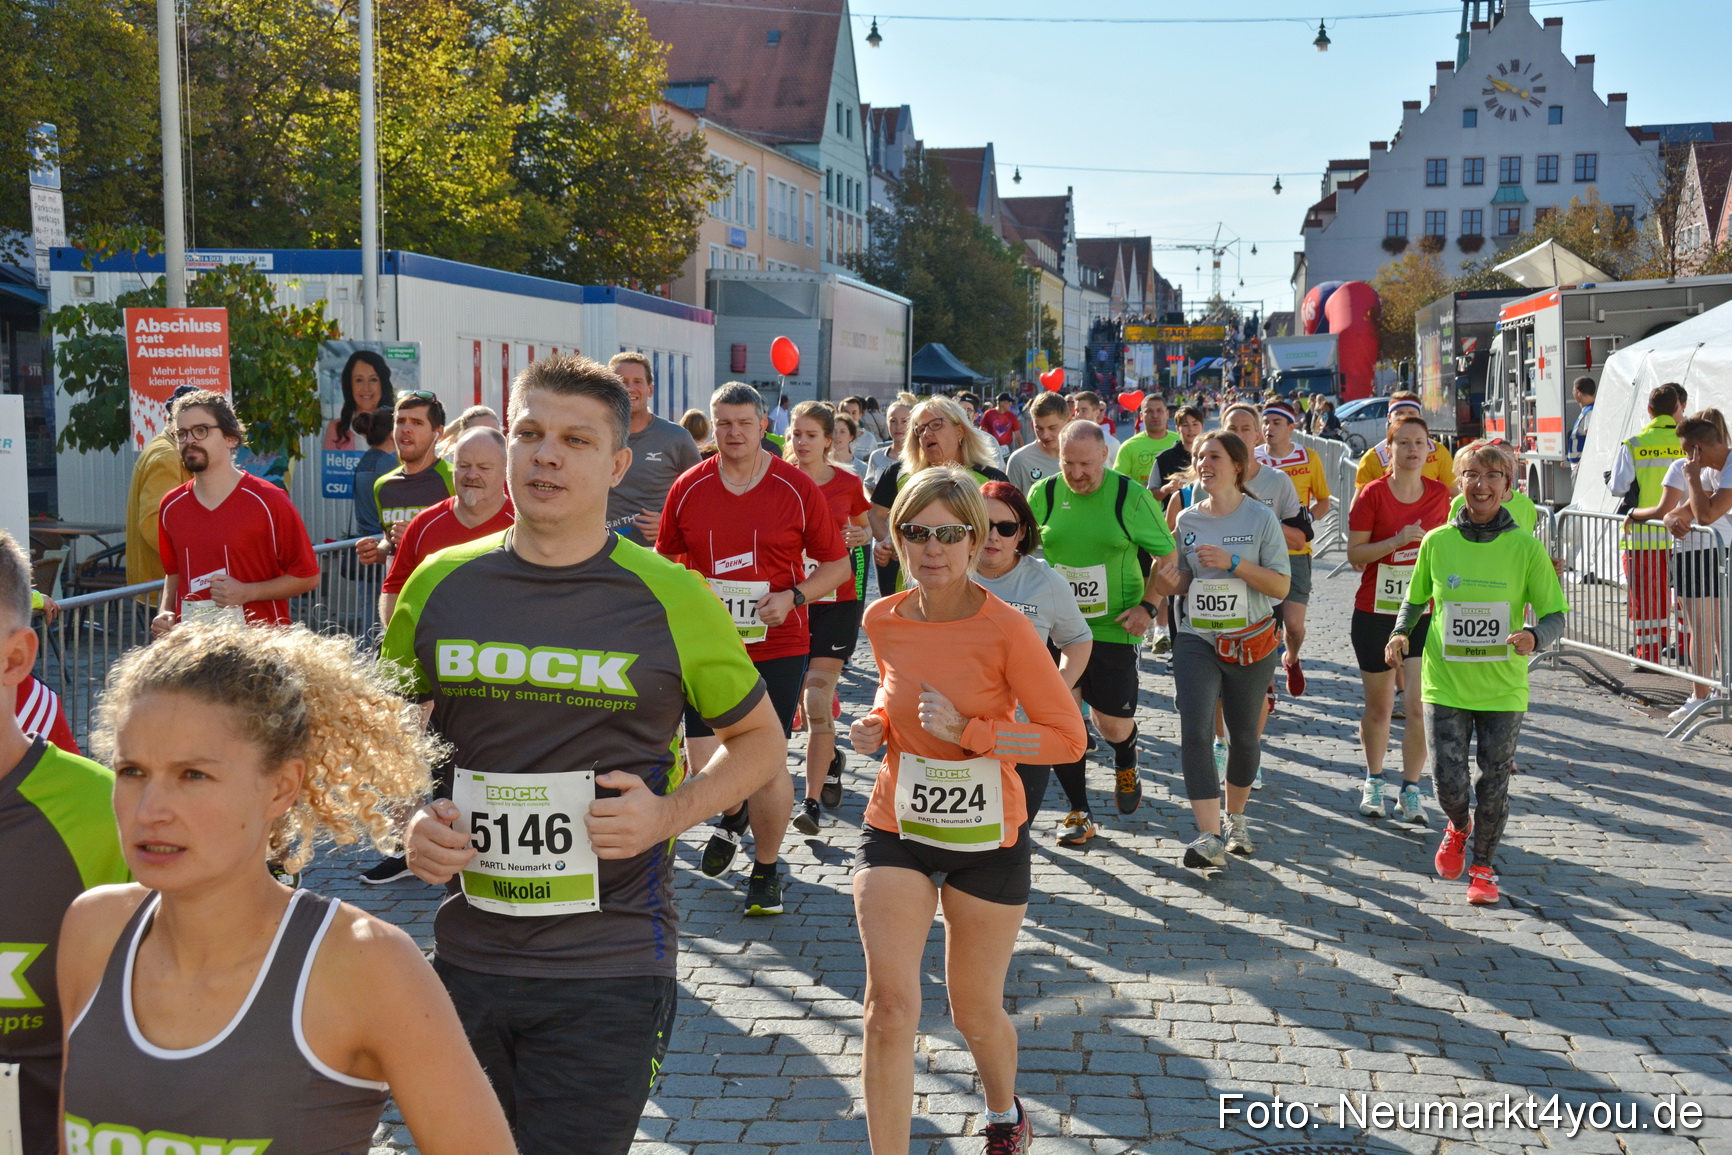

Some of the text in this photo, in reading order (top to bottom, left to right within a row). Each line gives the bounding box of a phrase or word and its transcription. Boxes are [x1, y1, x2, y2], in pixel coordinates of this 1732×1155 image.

[135, 317, 222, 333] Abschluss
[135, 334, 165, 344] statt
[1157, 328, 1192, 338] START
[136, 344, 223, 358] Ausschluss!
[152, 365, 221, 376] Mehr Lehrer für
[148, 376, 221, 387] kleinere Klassen.
[326, 453, 360, 471] Helga
[325, 482, 348, 493] CSU
[1222, 534, 1254, 543] BOCK
[725, 558, 743, 569] DEHN
[722, 586, 752, 595] BOCK
[720, 598, 759, 618] 117
[1196, 594, 1238, 611] 5057
[1211, 621, 1224, 629] Ute
[1452, 619, 1500, 637] 5029
[1465, 647, 1487, 656] Petra
[436, 639, 640, 697] BOCK
[440, 684, 637, 712] inspired by smart concepts
[925, 766, 972, 780] BOCK
[486, 785, 549, 801] BOCK
[911, 783, 987, 814] 5224
[918, 816, 940, 824] PARTL
[471, 811, 573, 855] 5146
[480, 860, 551, 872] PARTL Neumarkt
[493, 880, 551, 900] Nikolai
[64, 1112, 275, 1155] BOCK
